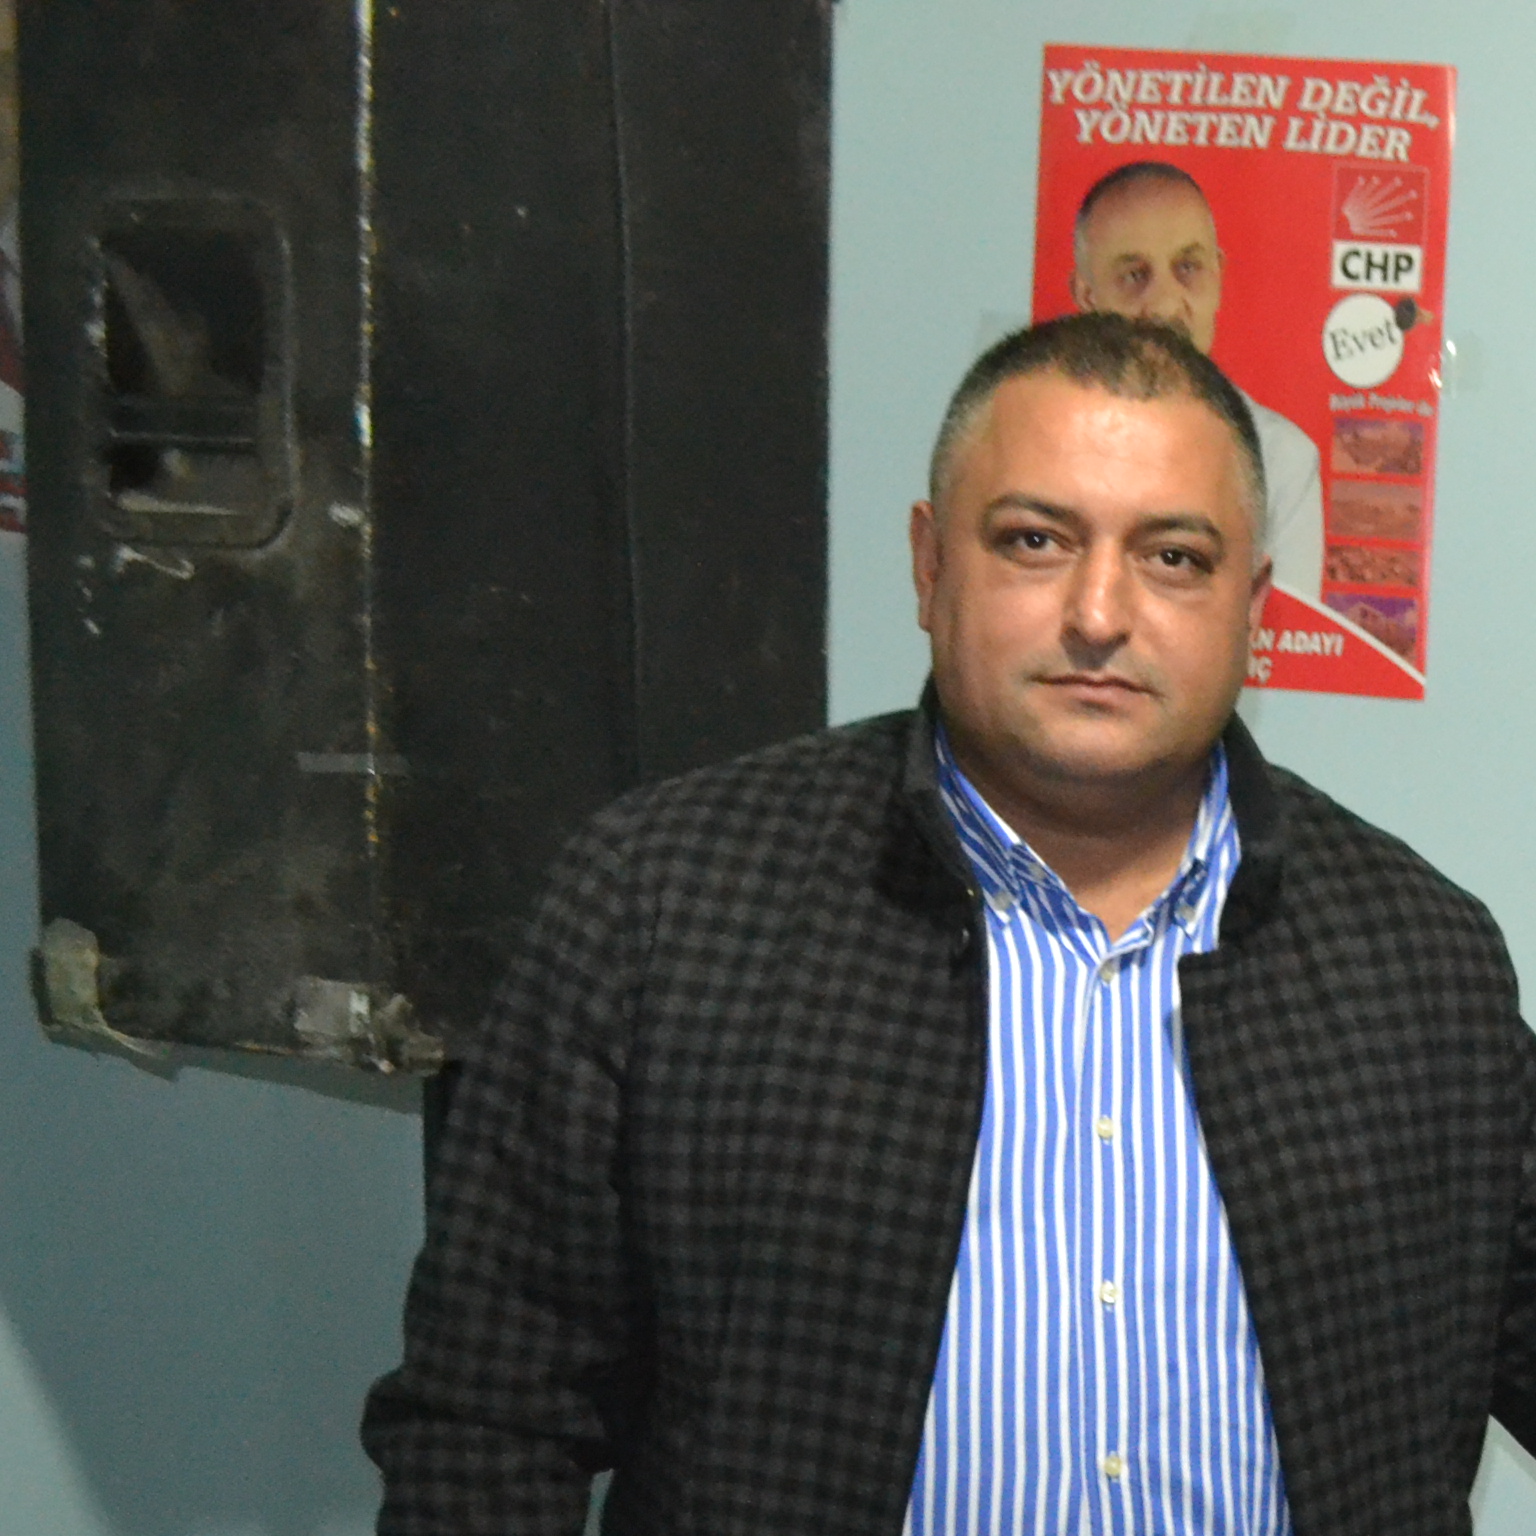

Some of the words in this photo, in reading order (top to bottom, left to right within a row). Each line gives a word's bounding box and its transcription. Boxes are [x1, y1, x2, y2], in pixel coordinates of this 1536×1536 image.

[1046, 61, 1292, 111] YÖNETİLEN
[1298, 74, 1441, 130] DEĞİL,
[1074, 102, 1277, 151] YÖNETEN
[1283, 112, 1413, 163] LİDER
[1341, 249, 1414, 283] CHP
[1329, 318, 1397, 361] Evet
[1277, 629, 1344, 657] ADAYI
